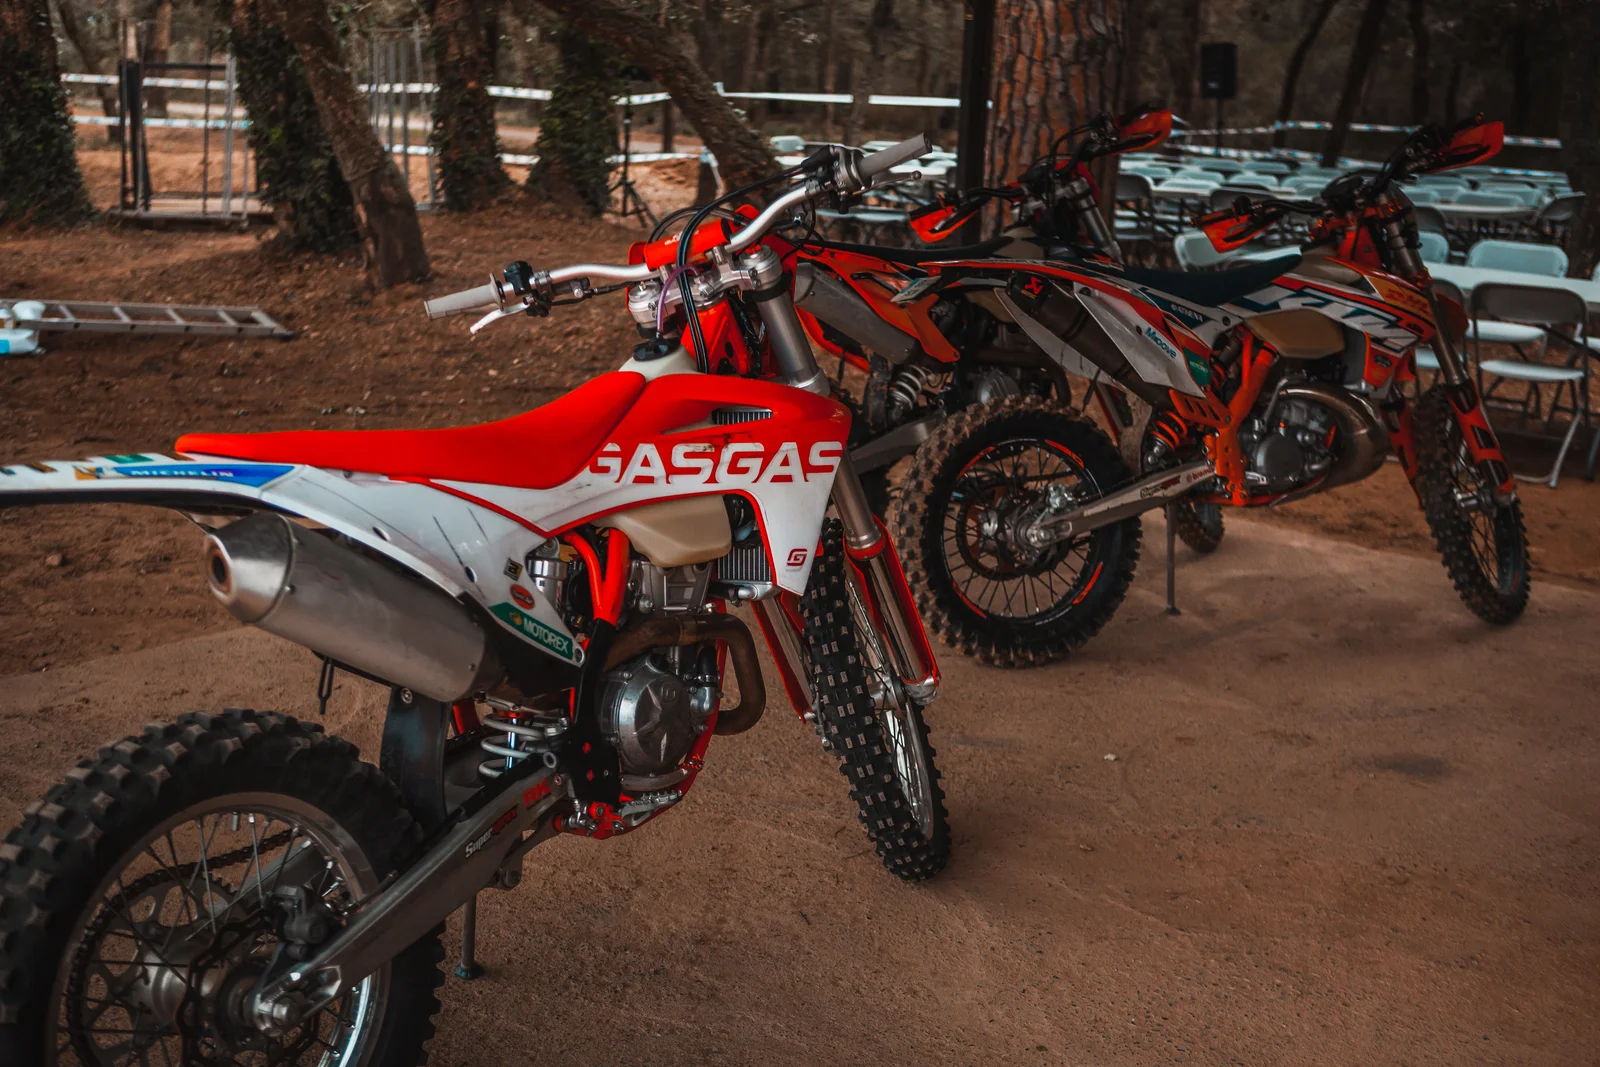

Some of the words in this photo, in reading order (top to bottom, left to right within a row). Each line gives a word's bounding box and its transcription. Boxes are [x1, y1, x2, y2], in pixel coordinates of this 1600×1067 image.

[588, 441, 843, 484] GASGAS
[523, 617, 569, 654] MOTOREX
[523, 777, 551, 807] RK
